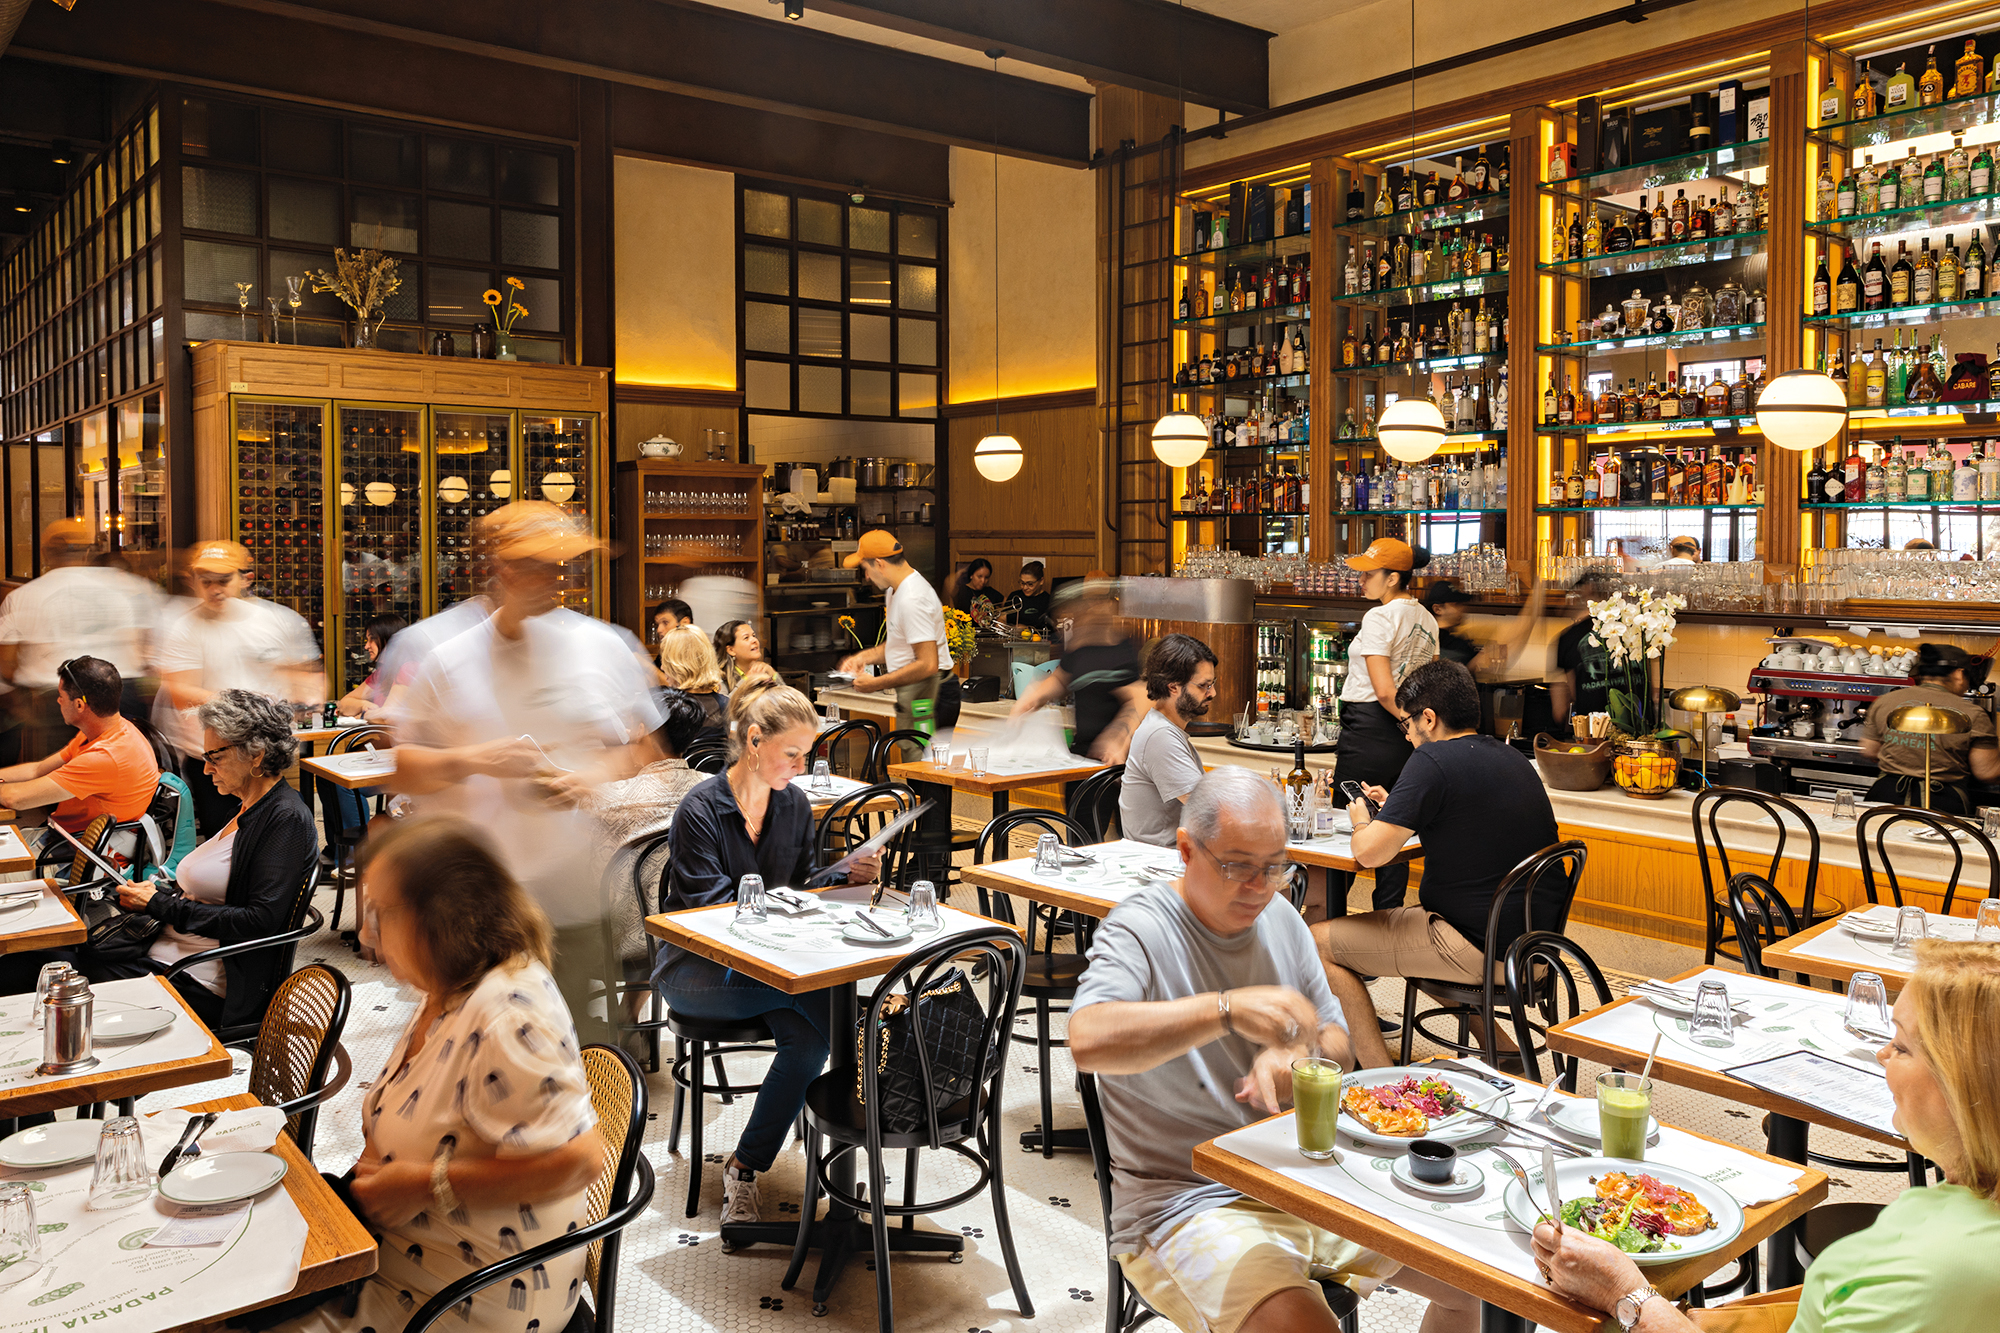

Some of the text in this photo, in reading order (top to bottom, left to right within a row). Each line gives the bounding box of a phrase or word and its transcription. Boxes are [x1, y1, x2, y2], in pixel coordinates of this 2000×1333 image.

[109, 1287, 138, 1302] onde
[61, 1286, 174, 1329] PADARIA
[72, 1301, 95, 1314] pão
[11, 1310, 70, 1328] encontra
